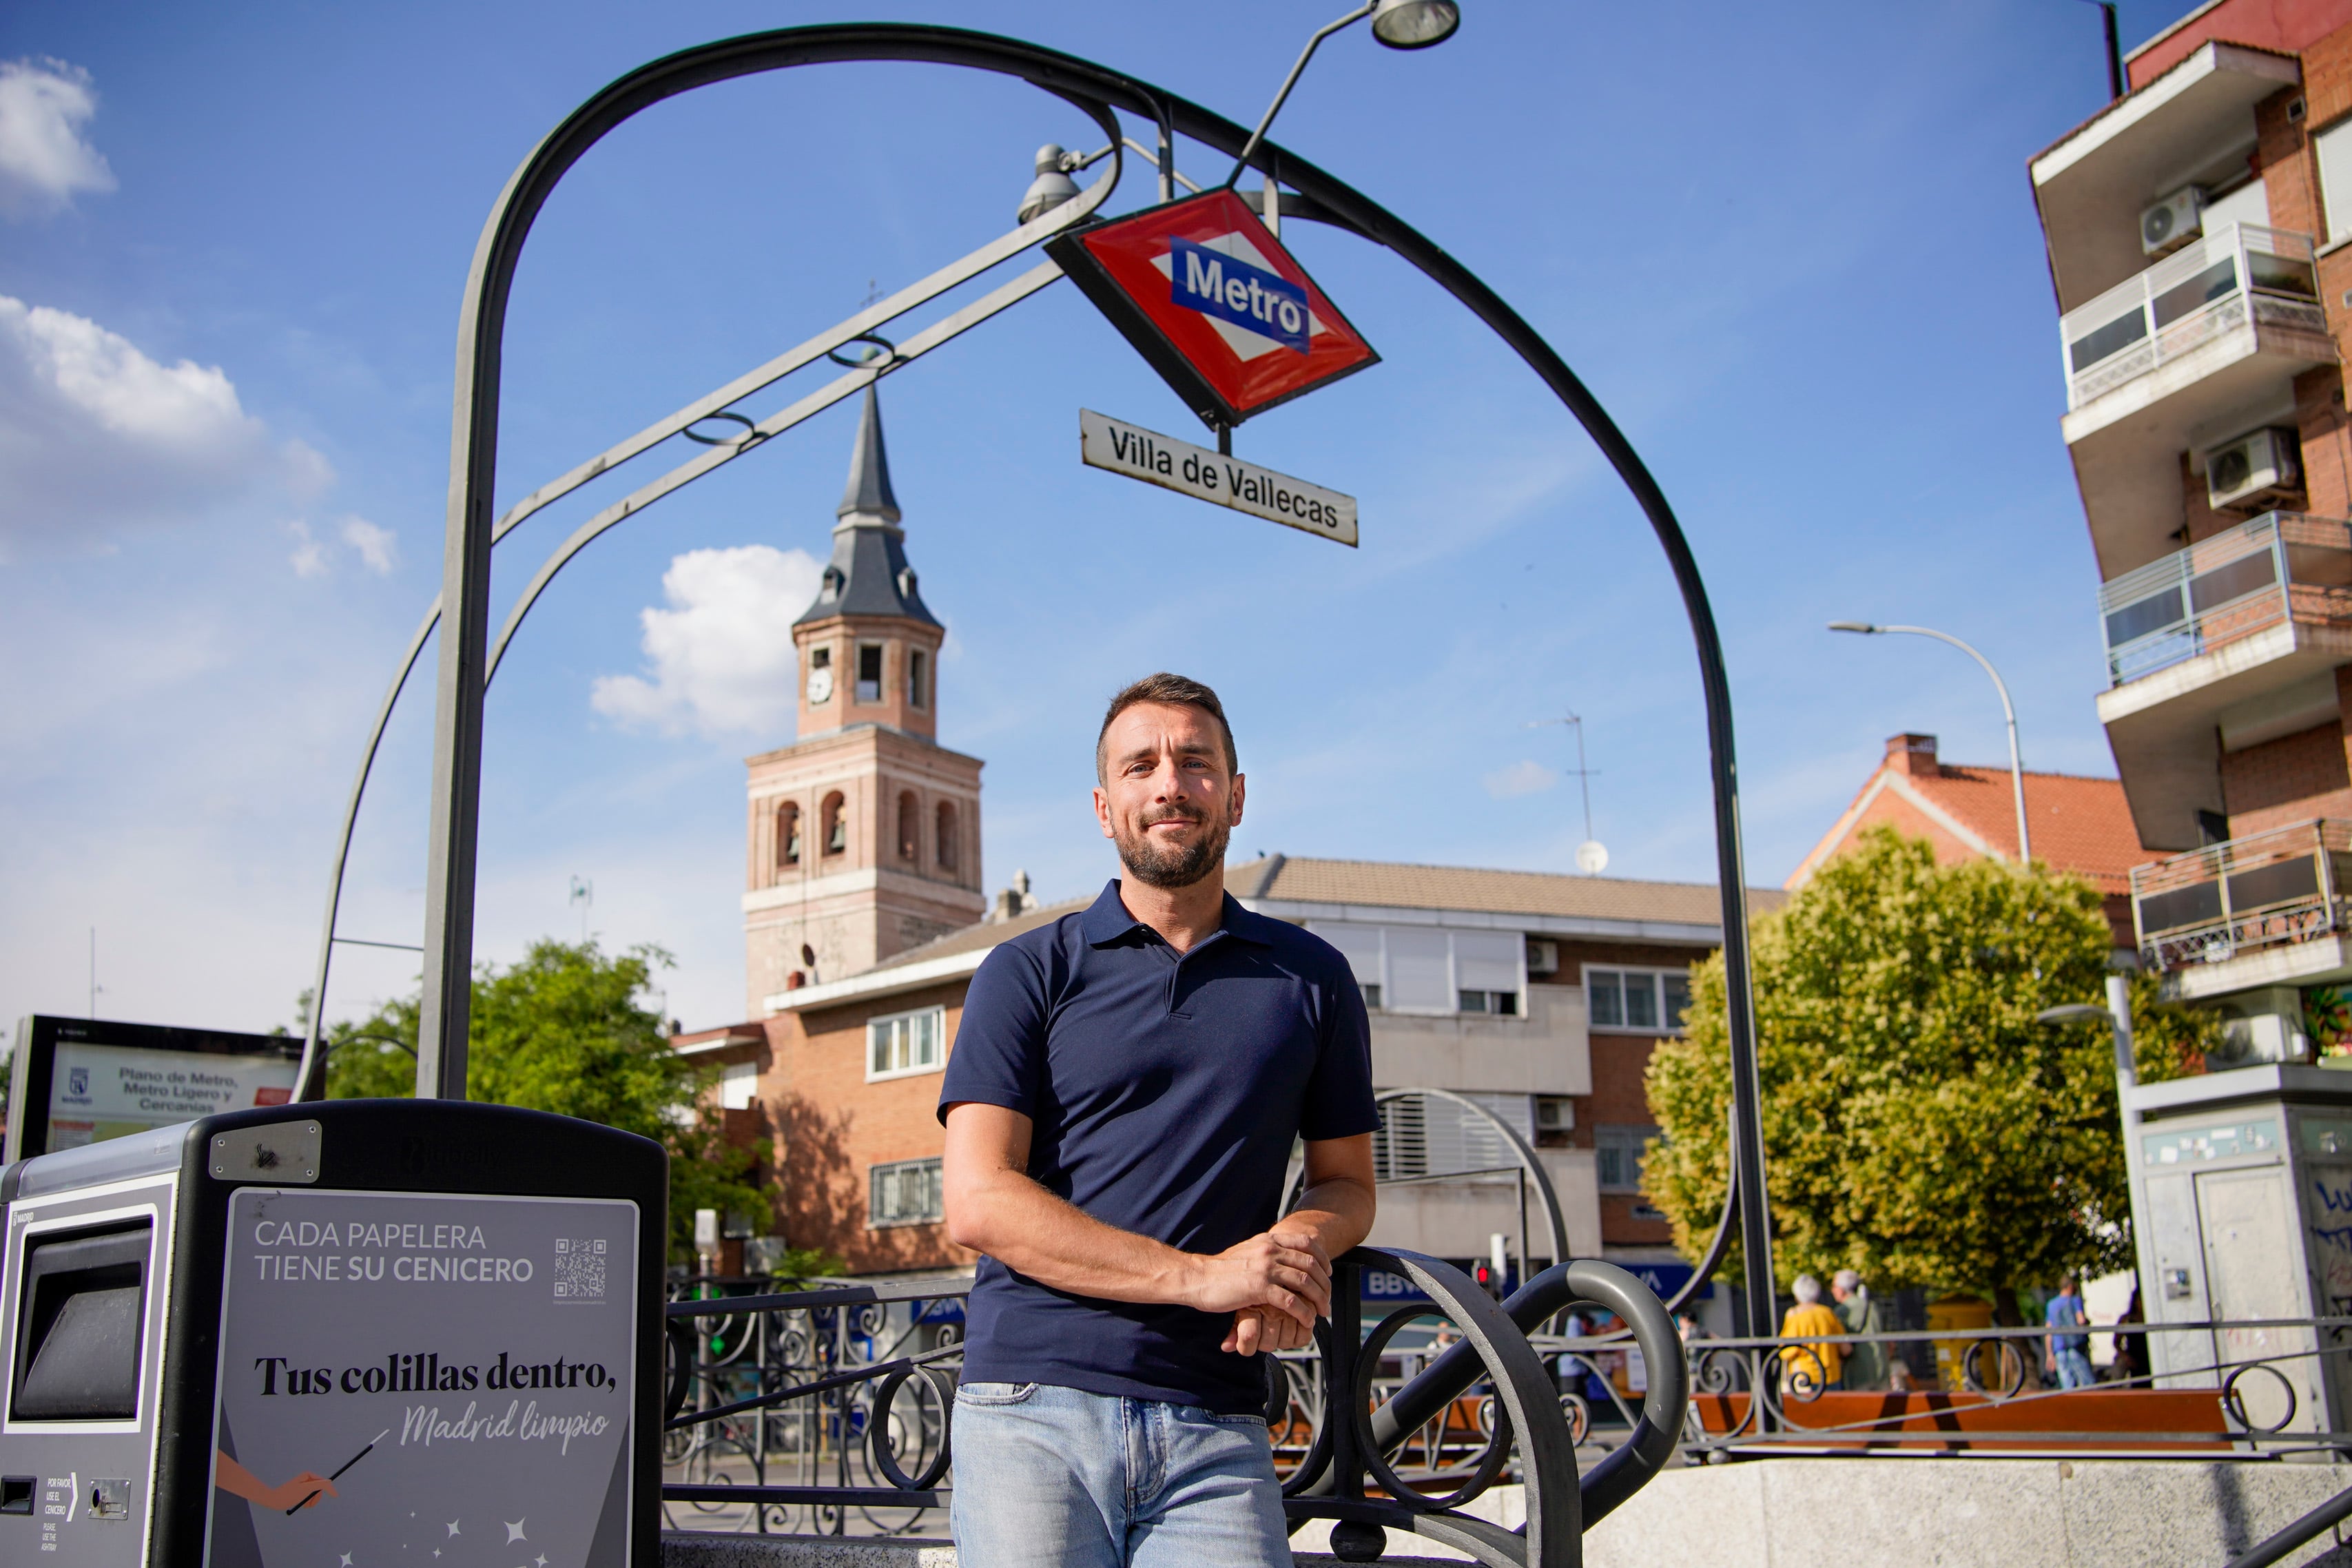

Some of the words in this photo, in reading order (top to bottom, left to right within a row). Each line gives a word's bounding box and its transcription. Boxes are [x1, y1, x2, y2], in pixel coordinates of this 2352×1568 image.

[1186, 250, 1301, 333] Metro
[1108, 426, 1173, 477] Villa
[1182, 453, 1218, 490] de
[1226, 464, 1338, 528] Vallecas
[119, 1067, 163, 1082] Plano
[167, 1071, 186, 1084] de
[190, 1072, 238, 1089] Metro,
[123, 1082, 169, 1097] Metro
[174, 1085, 220, 1100] Ligero
[224, 1091, 232, 1102] y
[254, 1221, 340, 1247] CADA
[347, 1224, 486, 1249] PAPELERA
[254, 1255, 340, 1281] TIENE
[347, 1257, 385, 1281] SU
[393, 1257, 533, 1282] CENICERO
[254, 1357, 332, 1396] Tus
[340, 1352, 479, 1394] colillas
[486, 1352, 617, 1394] dentro,
[400, 1400, 519, 1445] Madrid
[520, 1400, 610, 1456] limpio
[46, 1492, 54, 1500] USE
[55, 1492, 60, 1500] EL
[48, 1478, 56, 1487] POR
[45, 1505, 66, 1515] CENICERO
